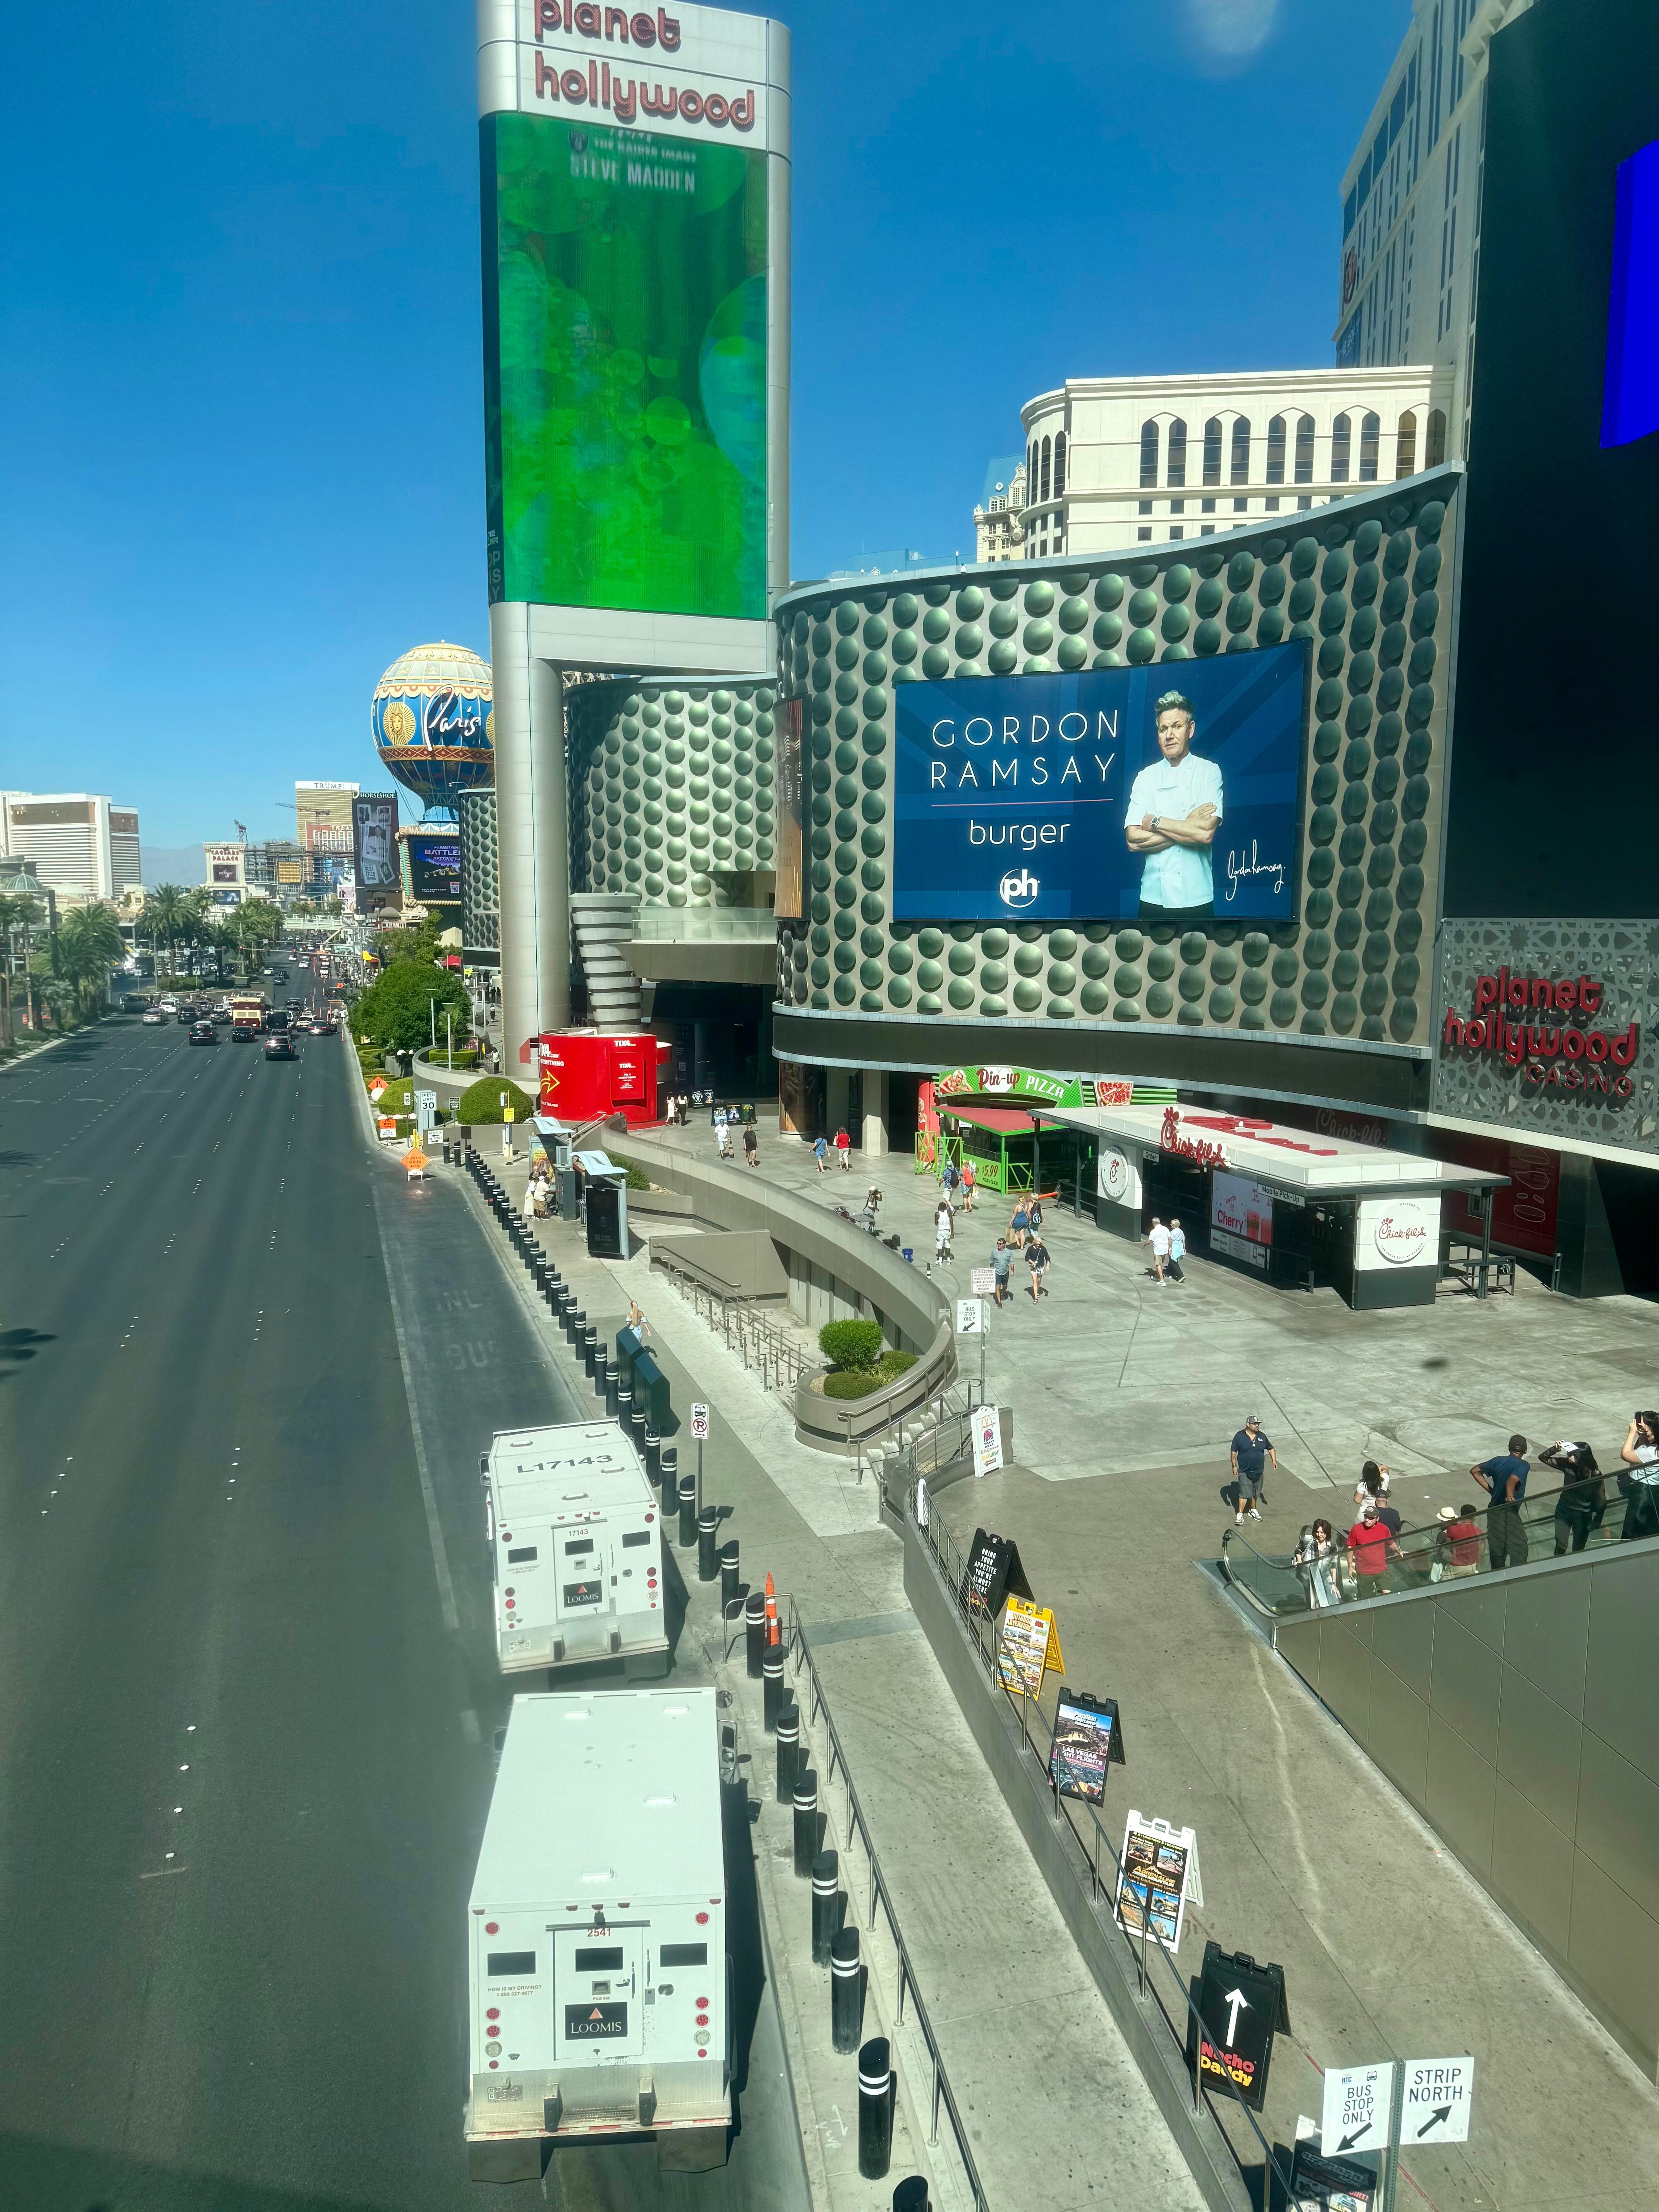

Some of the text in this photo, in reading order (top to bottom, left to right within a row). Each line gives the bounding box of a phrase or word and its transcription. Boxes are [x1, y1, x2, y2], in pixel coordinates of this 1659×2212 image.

[534, 0, 680, 46] planet
[535, 50, 754, 125] hollywood
[424, 684, 481, 752] Paris
[931, 709, 1118, 747] GORDON
[930, 753, 1115, 789] RAMSAY
[970, 819, 1070, 851] burger
[1476, 965, 1600, 1014] planet
[1445, 1007, 1638, 1066] hollywood
[976, 1067, 1020, 1091] Pin-up
[1527, 1065, 1633, 1096] CASINO
[1025, 1075, 1065, 1099] PIZZA
[1161, 1108, 1231, 1167] Chick-fil-A
[1145, 1152, 1157, 1160] Order
[982, 1164, 998, 1178] $5.99
[1262, 1185, 1278, 1197] Mobile
[1279, 1191, 1300, 1204] Pick-Up
[1217, 1210, 1243, 1233] Cherry
[1379, 1223, 1427, 1240] Chick-fil-A
[982, 1449, 999, 1461] SUBWAY
[517, 1455, 613, 1473] L17143
[568, 1528, 589, 1537] 17143
[981, 1548, 996, 1559] BRING
[981, 1555, 993, 1566] YOUR
[974, 1560, 997, 1575] APPETITE
[975, 1568, 993, 1580] YOU'RE
[973, 1575, 991, 1587] ALMOST
[567, 1593, 599, 1604] LOOMIS
[1006, 1618, 1036, 1633] ADVENTURES
[1012, 1613, 1033, 1625] OUTDOOR
[1074, 1711, 1097, 1722] Papillon
[1062, 1745, 1097, 1759] LAS VEGAS
[1076, 1754, 1103, 1766] FLIGHTS
[1133, 1865, 1176, 1884] ADRENALINE
[587, 1927, 611, 1937] 2541
[571, 2021, 622, 2033] LOOMIS
[1202, 2041, 1254, 2073] Nacho
[1414, 2068, 1462, 2085] STRIP
[1347, 2084, 1371, 2099] BUS
[1408, 2085, 1463, 2103] NORTH
[1344, 2097, 1374, 2112] STOP
[1342, 2109, 1374, 2125] ONLY
[1338, 2174, 1362, 2188] RACING
[1349, 2190, 1369, 2201] DIRT!
